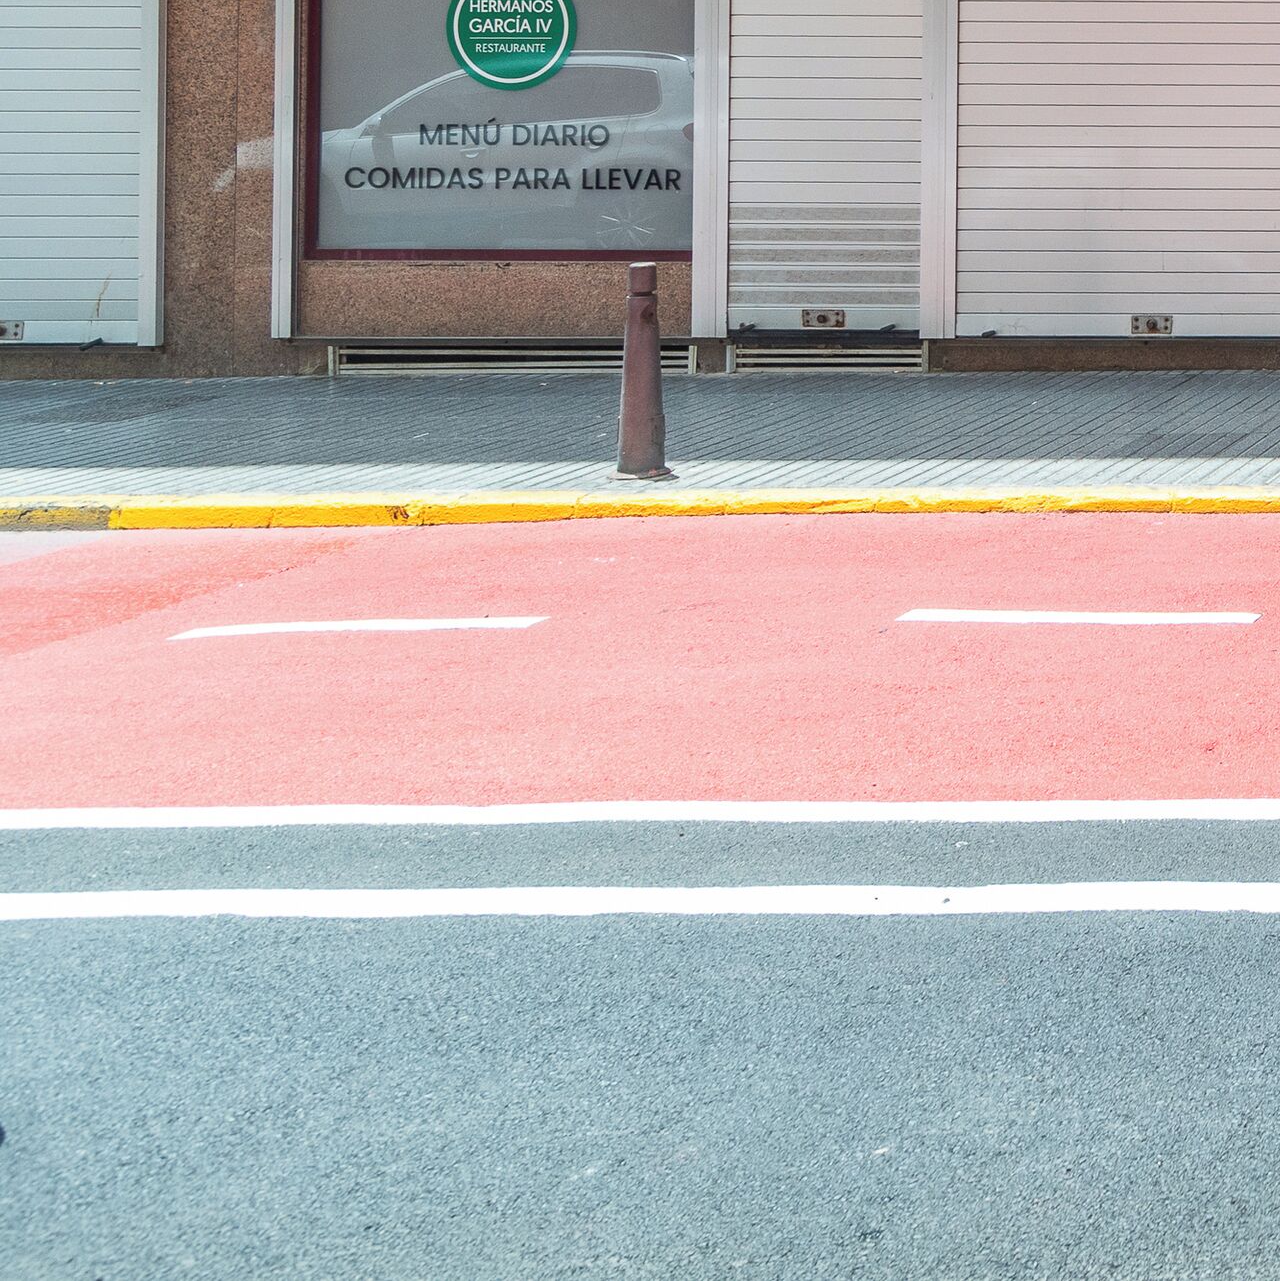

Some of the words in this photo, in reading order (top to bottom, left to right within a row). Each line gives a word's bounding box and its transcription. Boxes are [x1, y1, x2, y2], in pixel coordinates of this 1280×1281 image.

[469, 0, 554, 13] HERMANOS
[468, 15, 532, 33] GARCÍA
[536, 18, 553, 33] IV
[475, 43, 546, 53] RESTAURANTE
[419, 118, 502, 146] MENÚ
[512, 124, 610, 147] DIARIO
[344, 167, 484, 190] COMIDAS
[495, 168, 572, 190] PARA
[582, 168, 682, 191] LLEVAR
